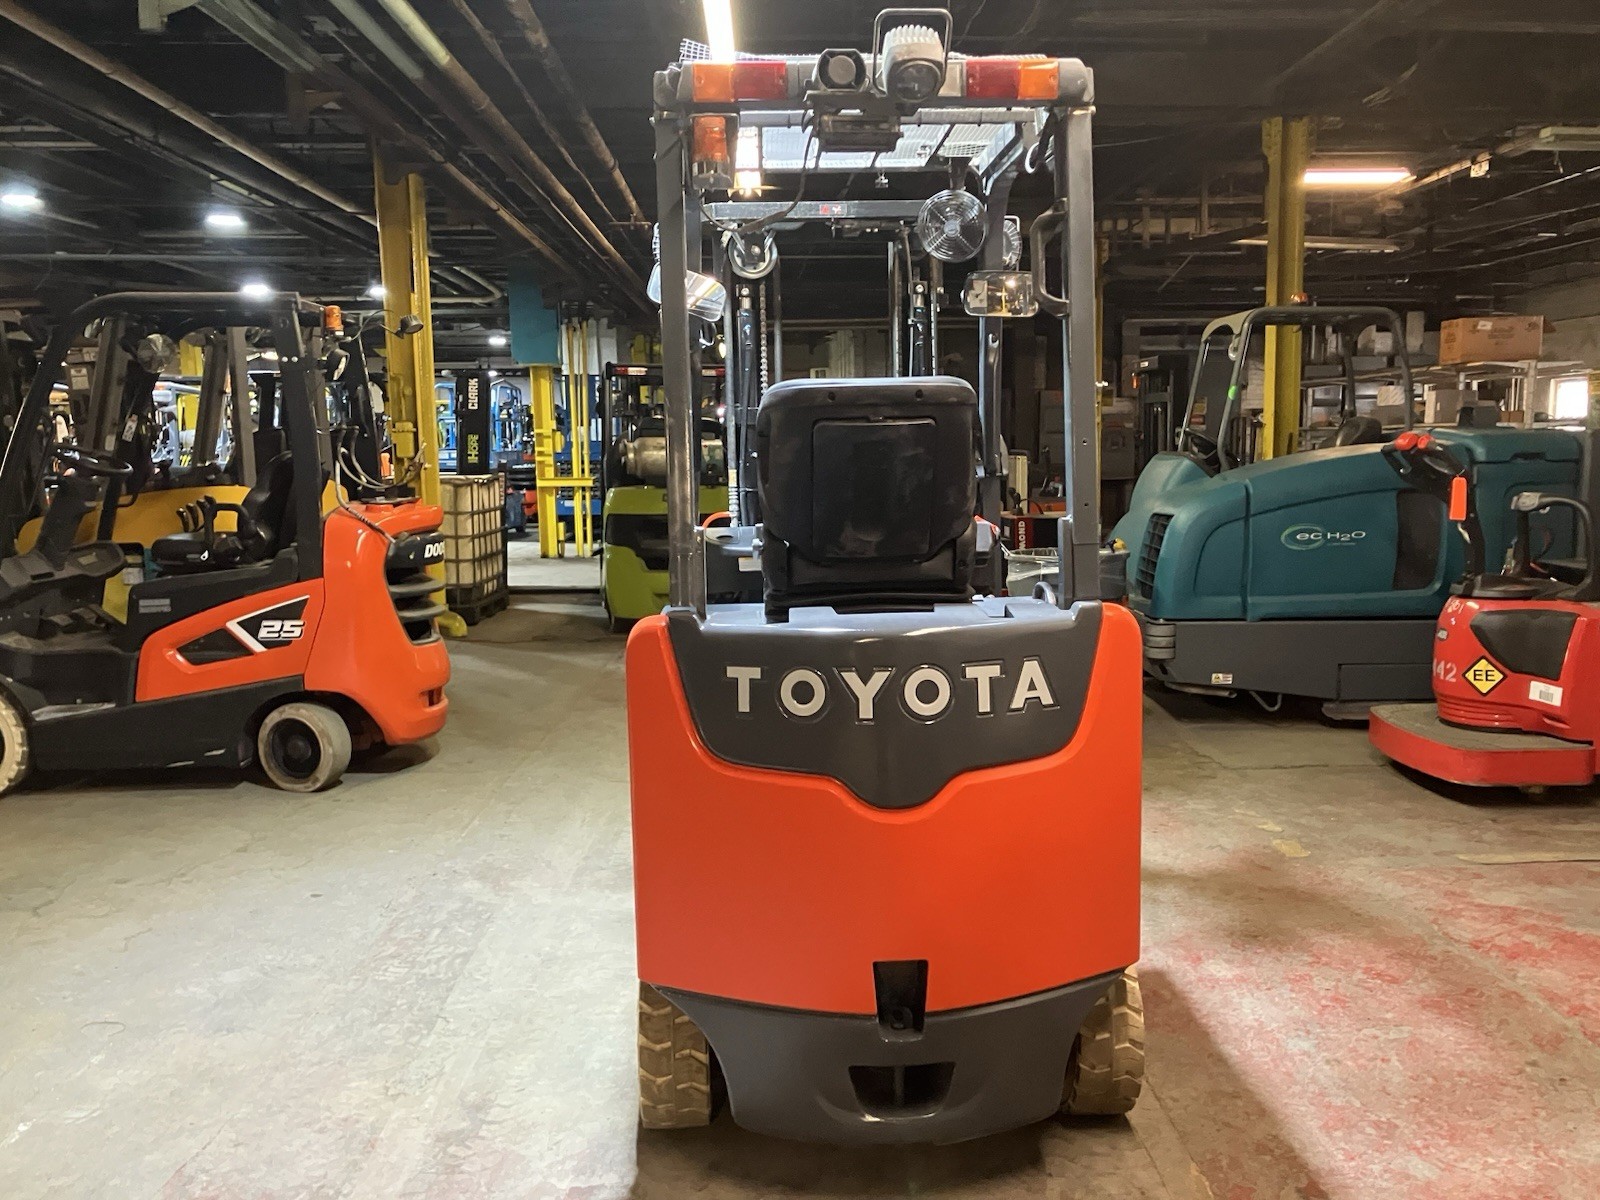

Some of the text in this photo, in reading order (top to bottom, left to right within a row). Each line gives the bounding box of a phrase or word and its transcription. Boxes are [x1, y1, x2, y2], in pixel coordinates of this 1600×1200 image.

[468, 378, 479, 410] CLARK
[1327, 530, 1366, 541] H2O
[257, 619, 306, 641] 25
[1473, 669, 1496, 682] EE
[725, 659, 1056, 719] TOYOTA
